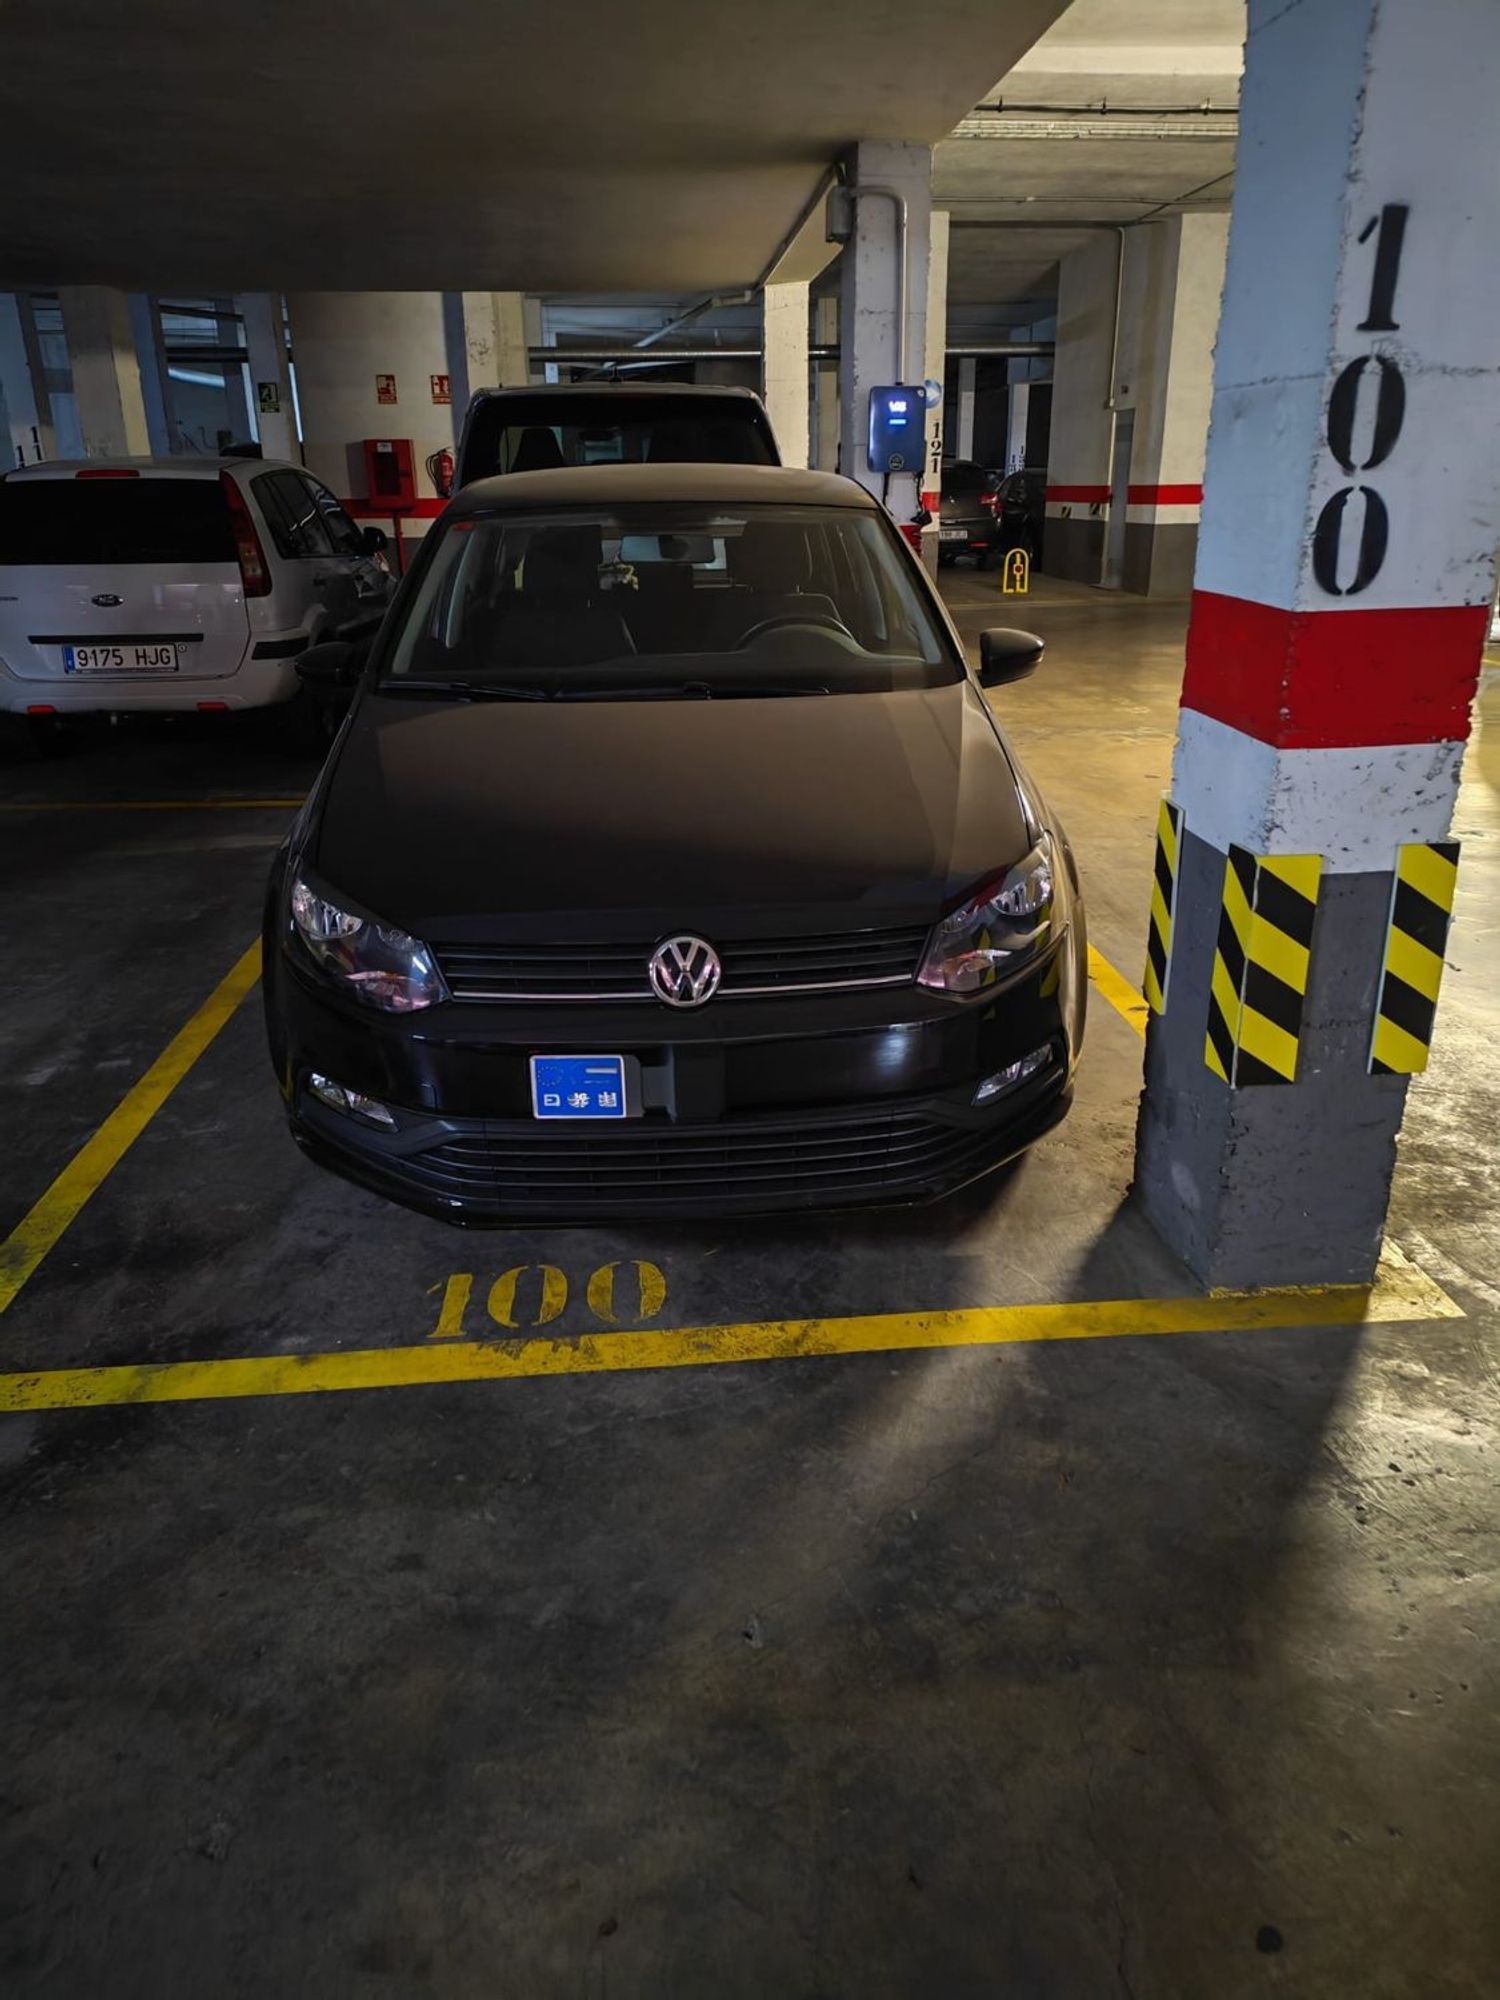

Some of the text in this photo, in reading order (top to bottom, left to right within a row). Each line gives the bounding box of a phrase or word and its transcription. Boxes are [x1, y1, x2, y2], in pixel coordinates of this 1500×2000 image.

[1312, 203, 1410, 596] 100
[931, 422, 942, 474] 121
[77, 648, 171, 667] 9175 HJG
[426, 1260, 667, 1338] 100
